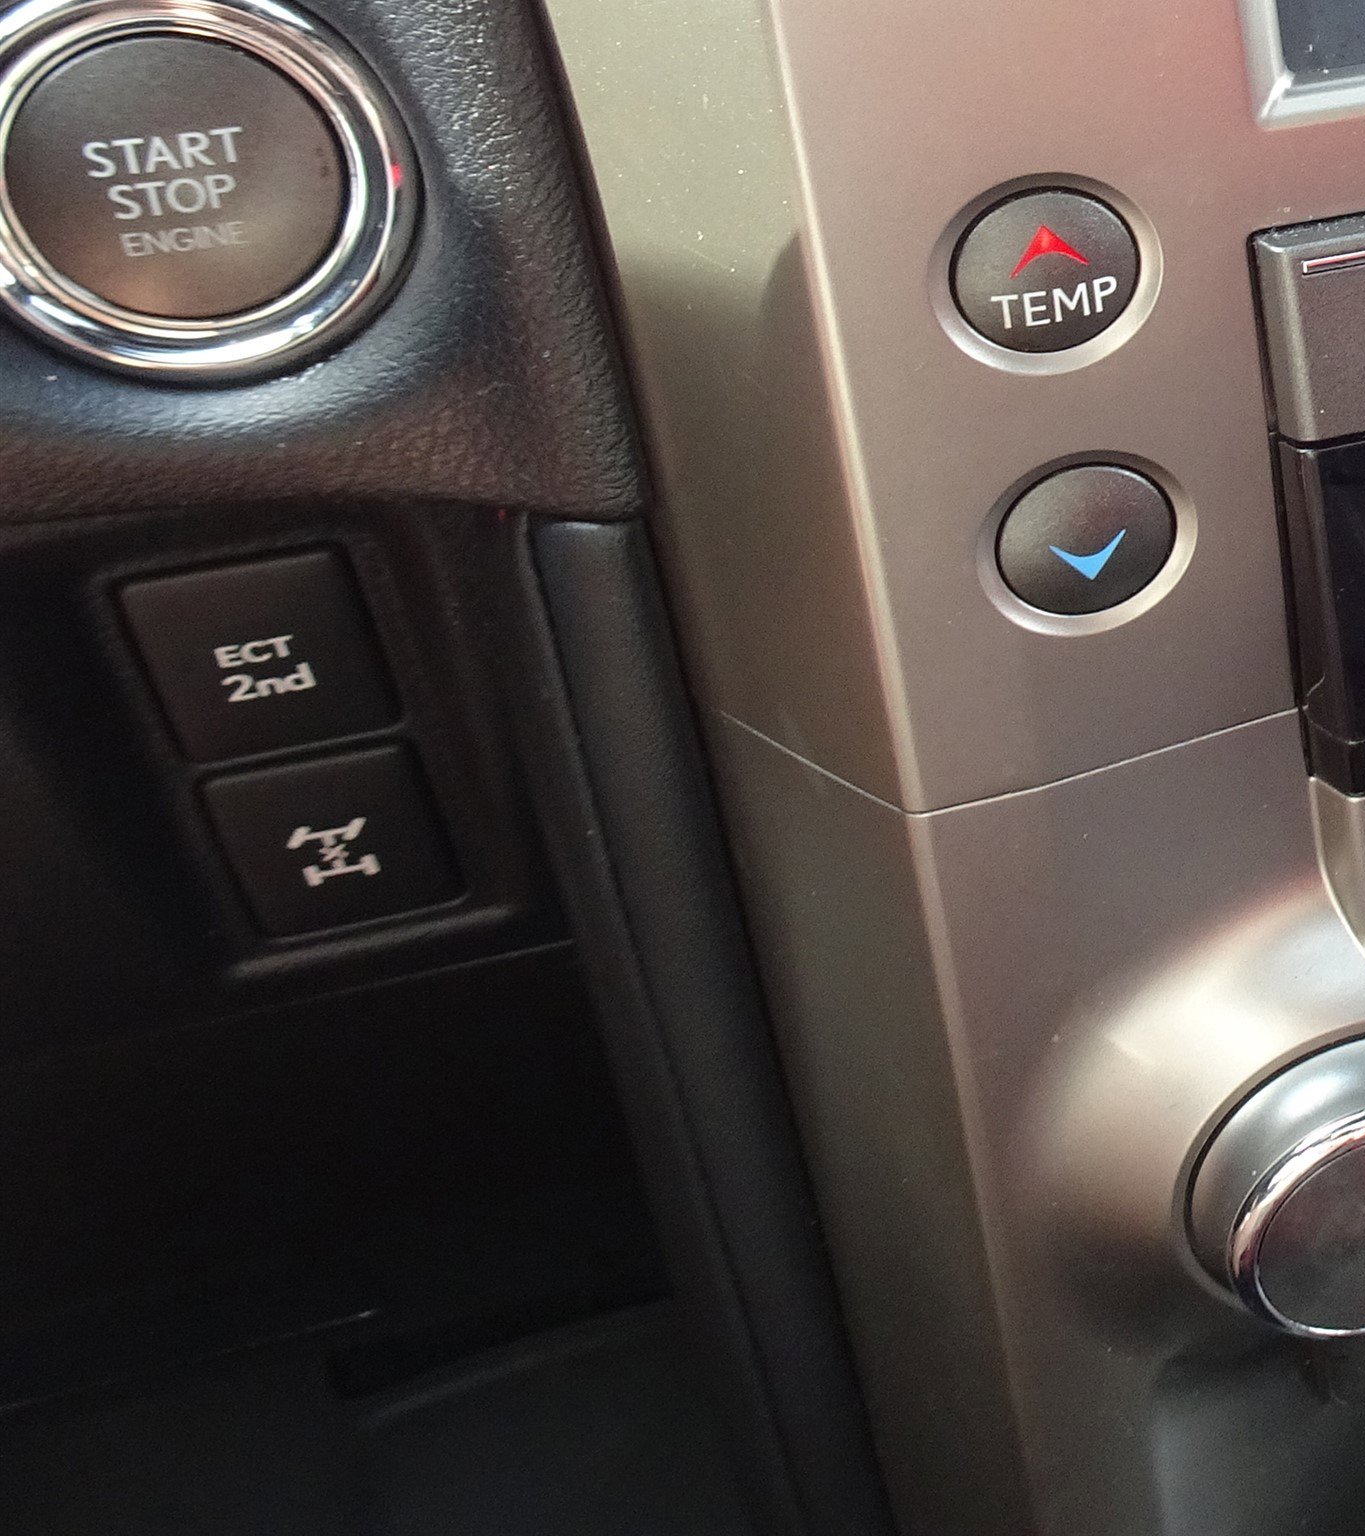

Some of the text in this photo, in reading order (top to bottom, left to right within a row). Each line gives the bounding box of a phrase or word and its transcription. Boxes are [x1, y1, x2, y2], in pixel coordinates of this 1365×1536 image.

[82, 126, 243, 179] START
[107, 173, 238, 221] STOP
[118, 221, 249, 257] ENGINE
[990, 275, 1119, 330] TEMP
[214, 634, 293, 668] ECT
[221, 662, 317, 702] 2nd
